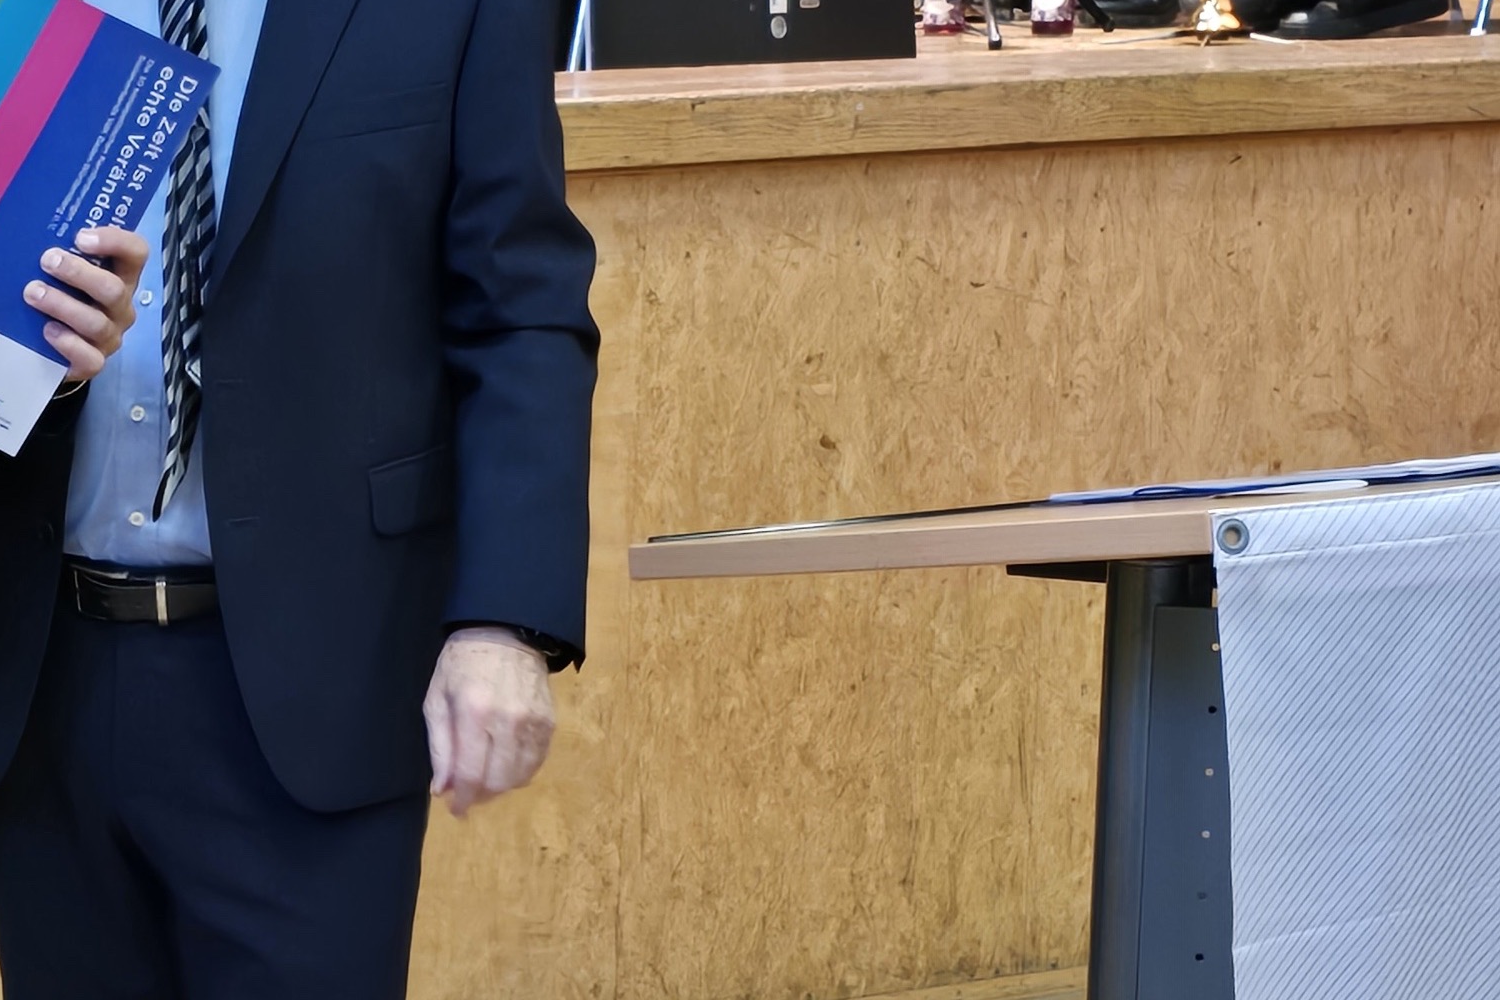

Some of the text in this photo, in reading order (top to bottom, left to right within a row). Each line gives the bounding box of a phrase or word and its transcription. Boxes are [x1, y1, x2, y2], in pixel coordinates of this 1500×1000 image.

[136, 65, 174, 127] echte
[168, 75, 199, 113] Die
[143, 116, 178, 160] Zeit
[84, 134, 146, 230] Veränder
[127, 164, 153, 191] ist
